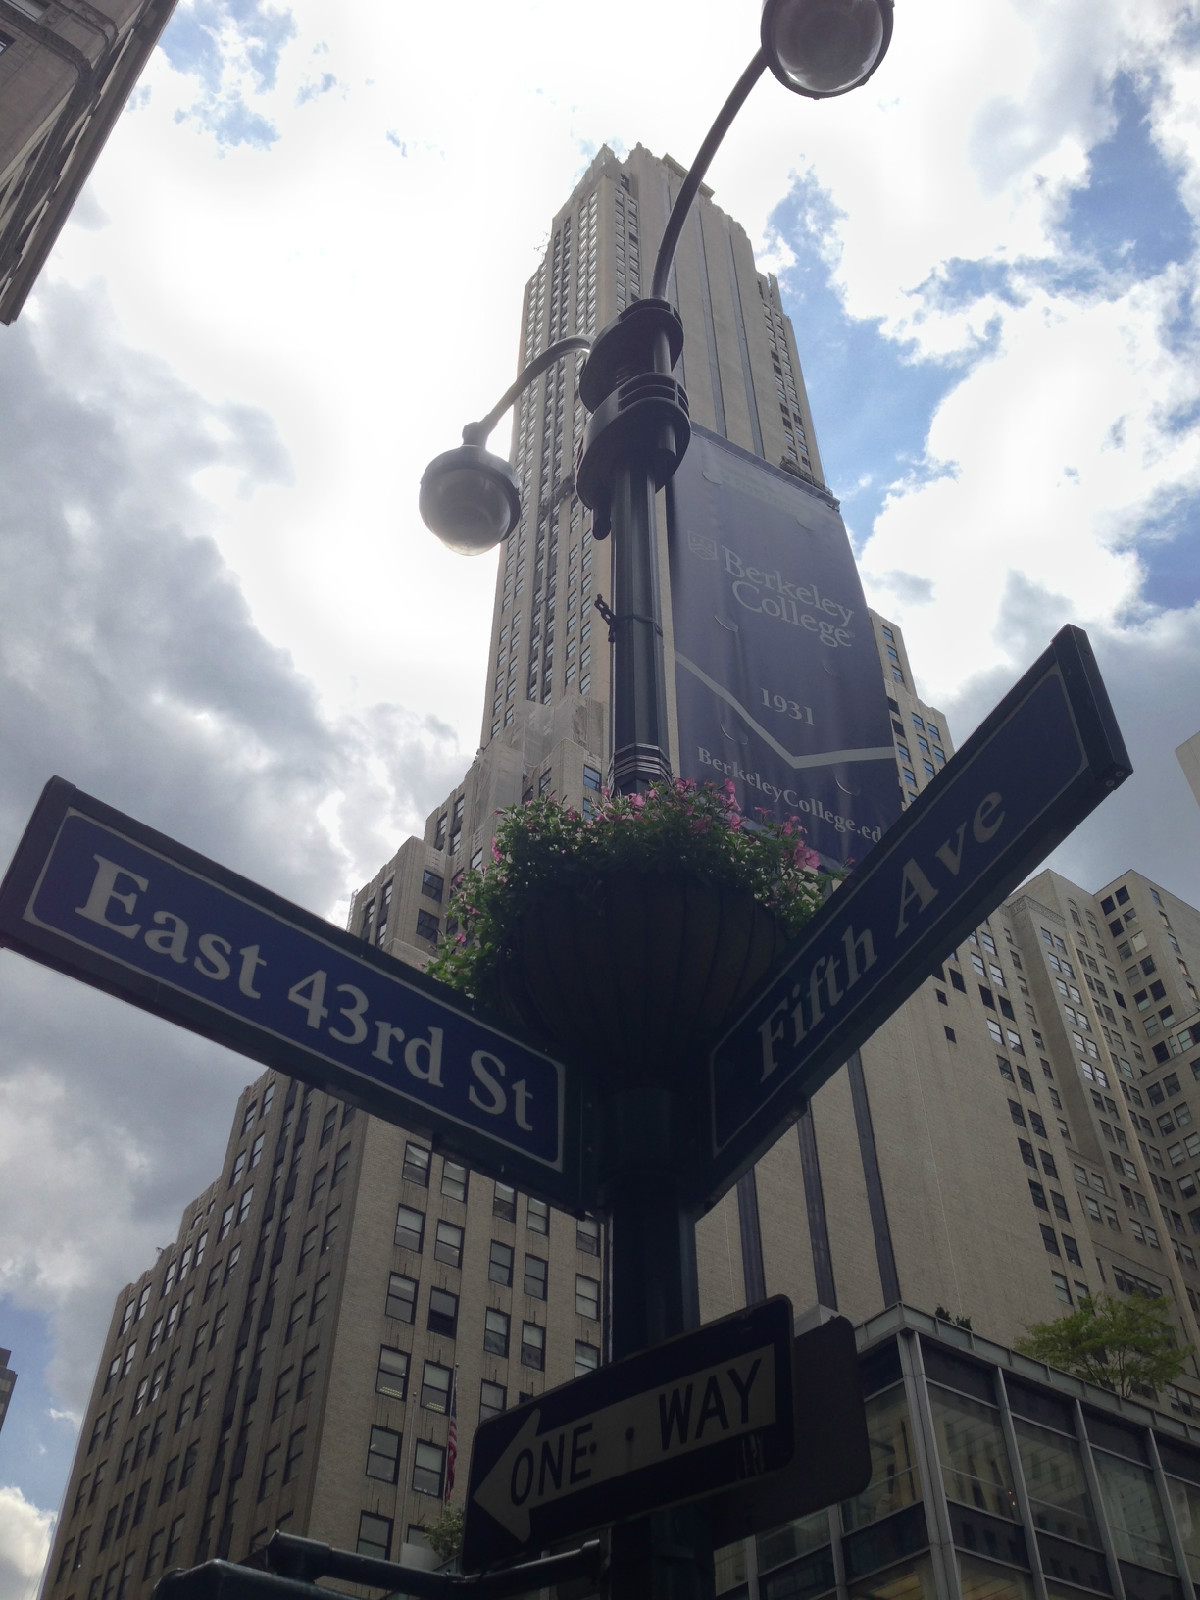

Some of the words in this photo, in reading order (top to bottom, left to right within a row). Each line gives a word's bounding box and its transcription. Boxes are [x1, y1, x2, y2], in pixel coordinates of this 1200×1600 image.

[721, 544, 855, 627] Berkeley
[732, 580, 853, 648] College
[760, 687, 815, 726] 1931
[75, 853, 268, 1000] East
[287, 969, 444, 1088] 43rd
[469, 1050, 534, 1132] St
[757, 924, 879, 1086] Fifth
[894, 790, 1006, 935] Ave
[510, 1422, 594, 1507] ONE
[658, 1358, 762, 1451] WAY
